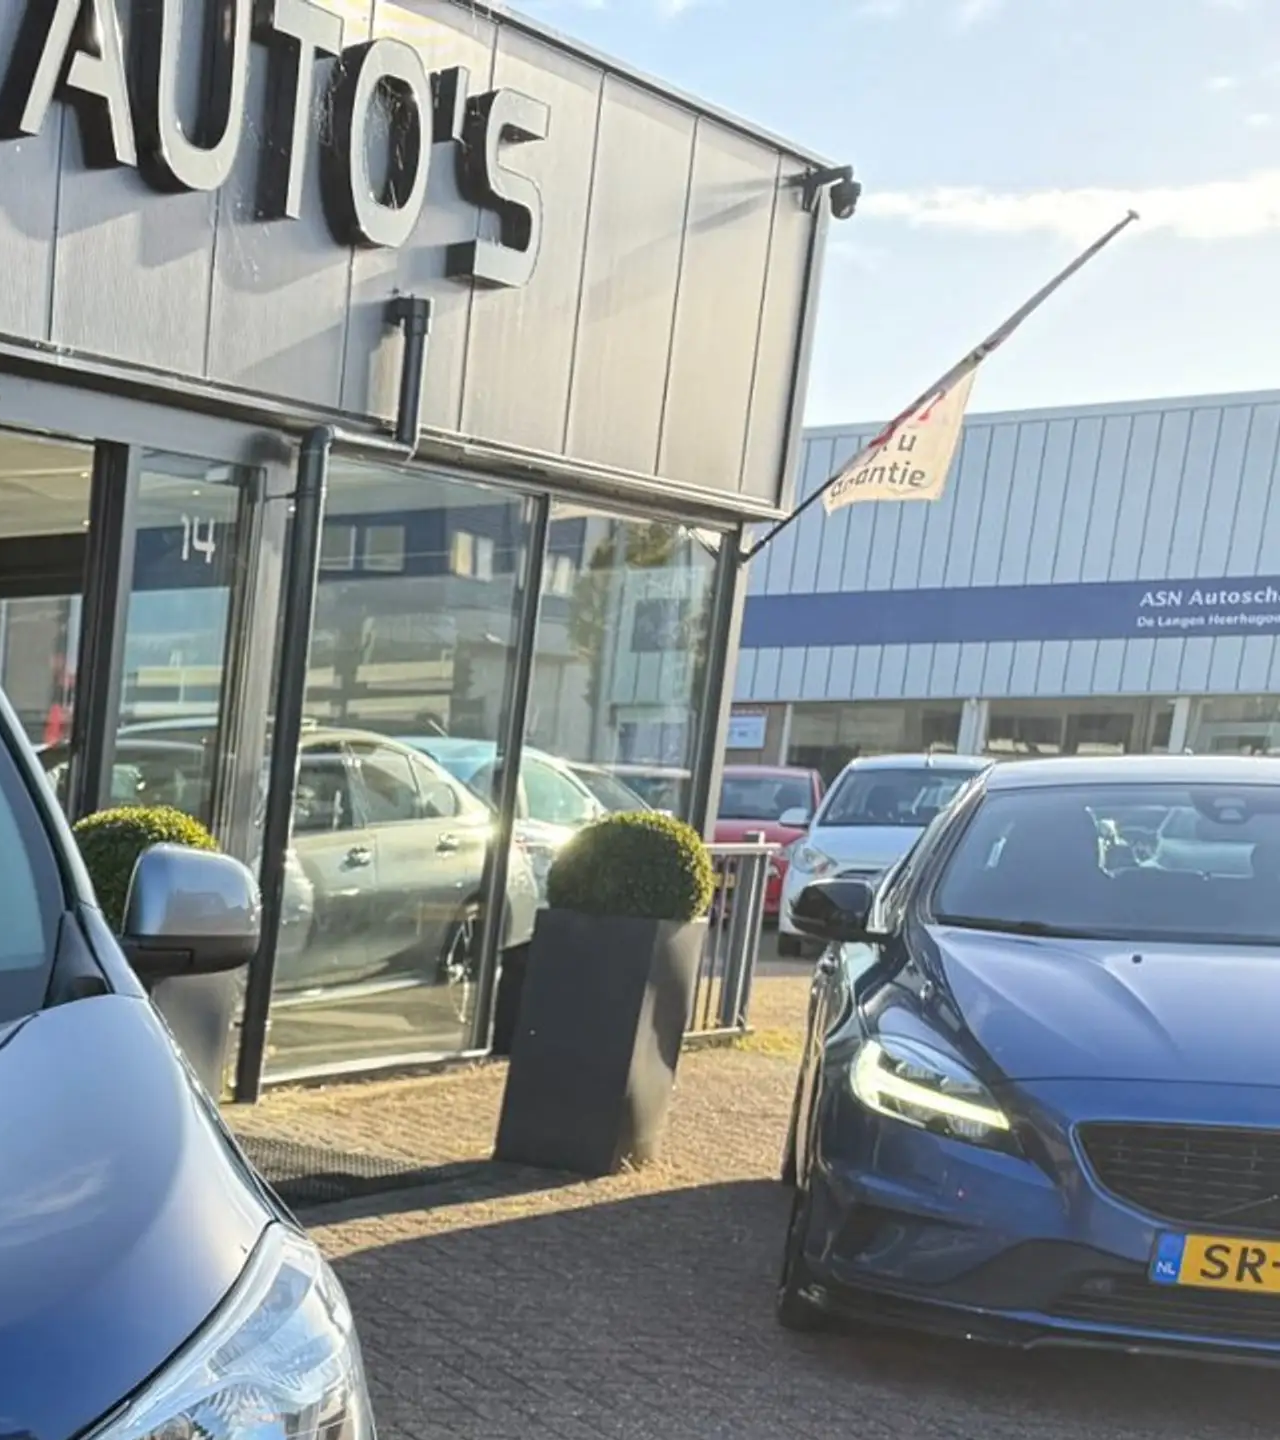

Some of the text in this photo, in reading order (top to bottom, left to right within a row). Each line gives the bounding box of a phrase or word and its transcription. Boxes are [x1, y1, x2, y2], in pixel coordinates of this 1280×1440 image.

[181, 513, 215, 563] 14
[1139, 586, 1280, 607] ASN Autosch
[1136, 615, 1155, 627] De
[1156, 1261, 1177, 1275] NL
